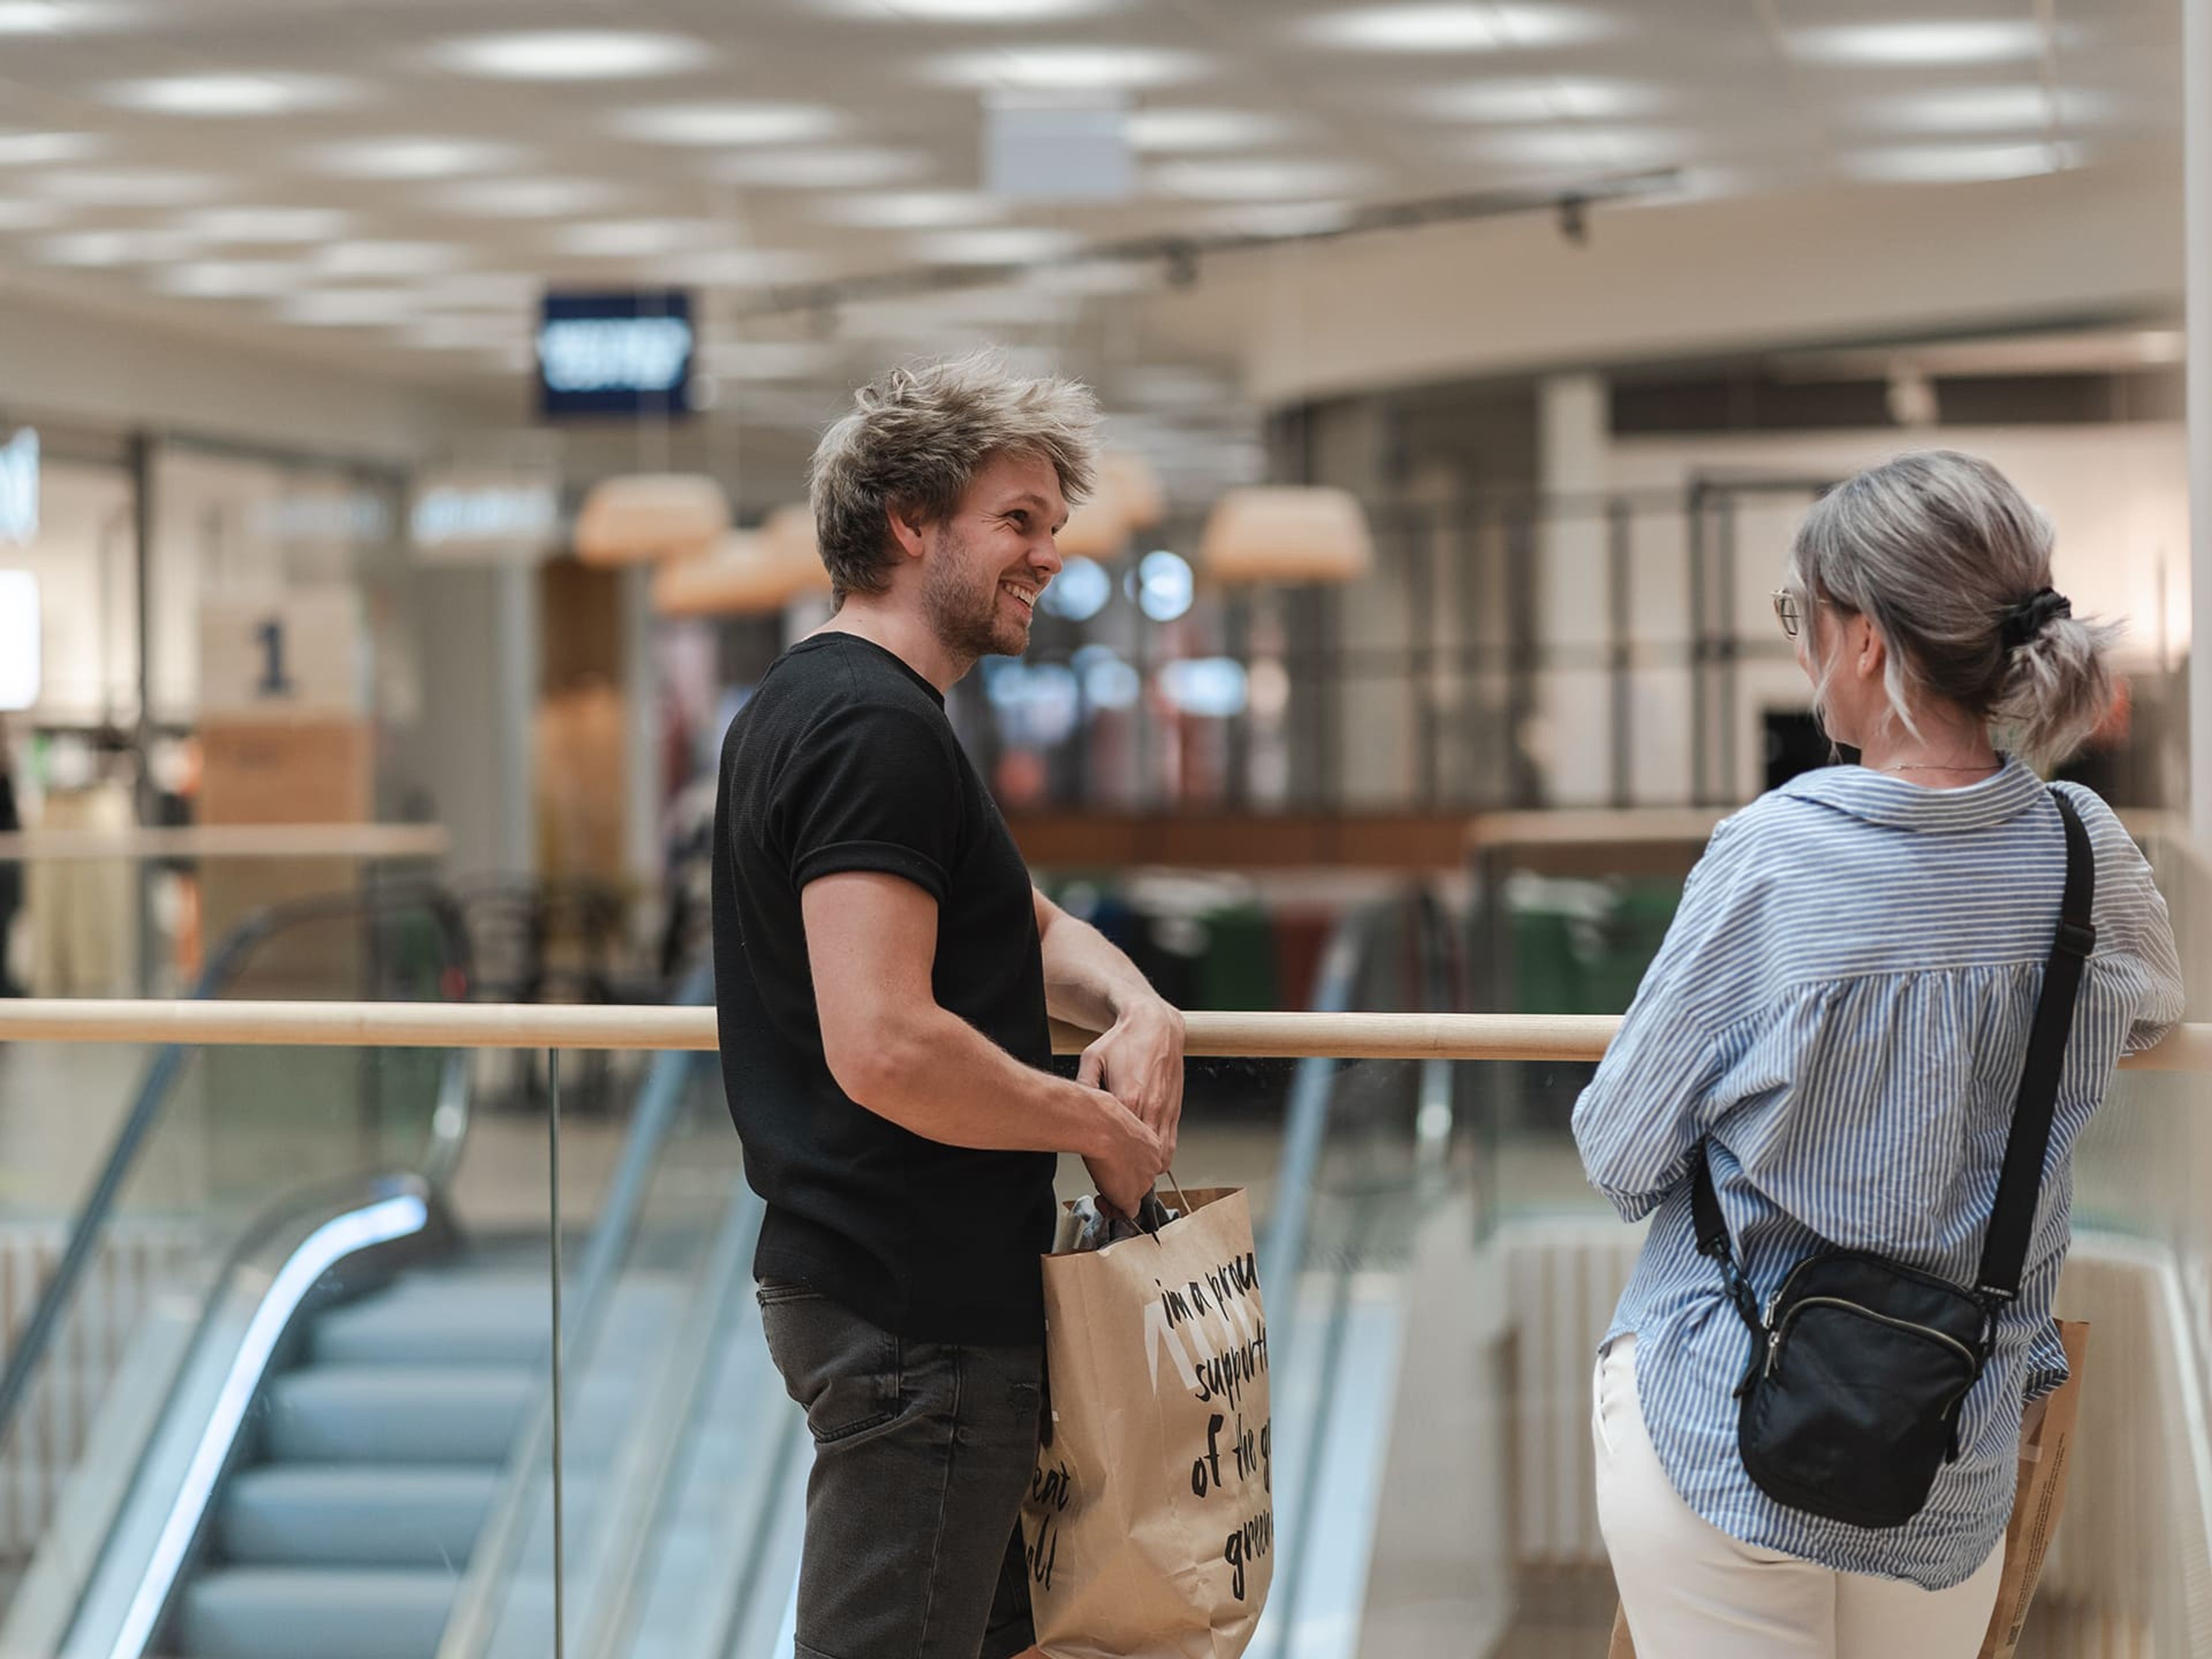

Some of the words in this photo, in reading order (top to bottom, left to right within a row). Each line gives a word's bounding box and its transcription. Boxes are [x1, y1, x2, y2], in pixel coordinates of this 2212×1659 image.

[253, 619, 296, 698] 1
[1188, 1282, 1213, 1317] a
[1192, 1414, 1224, 1498] of
[1232, 1413, 1256, 1482] the
